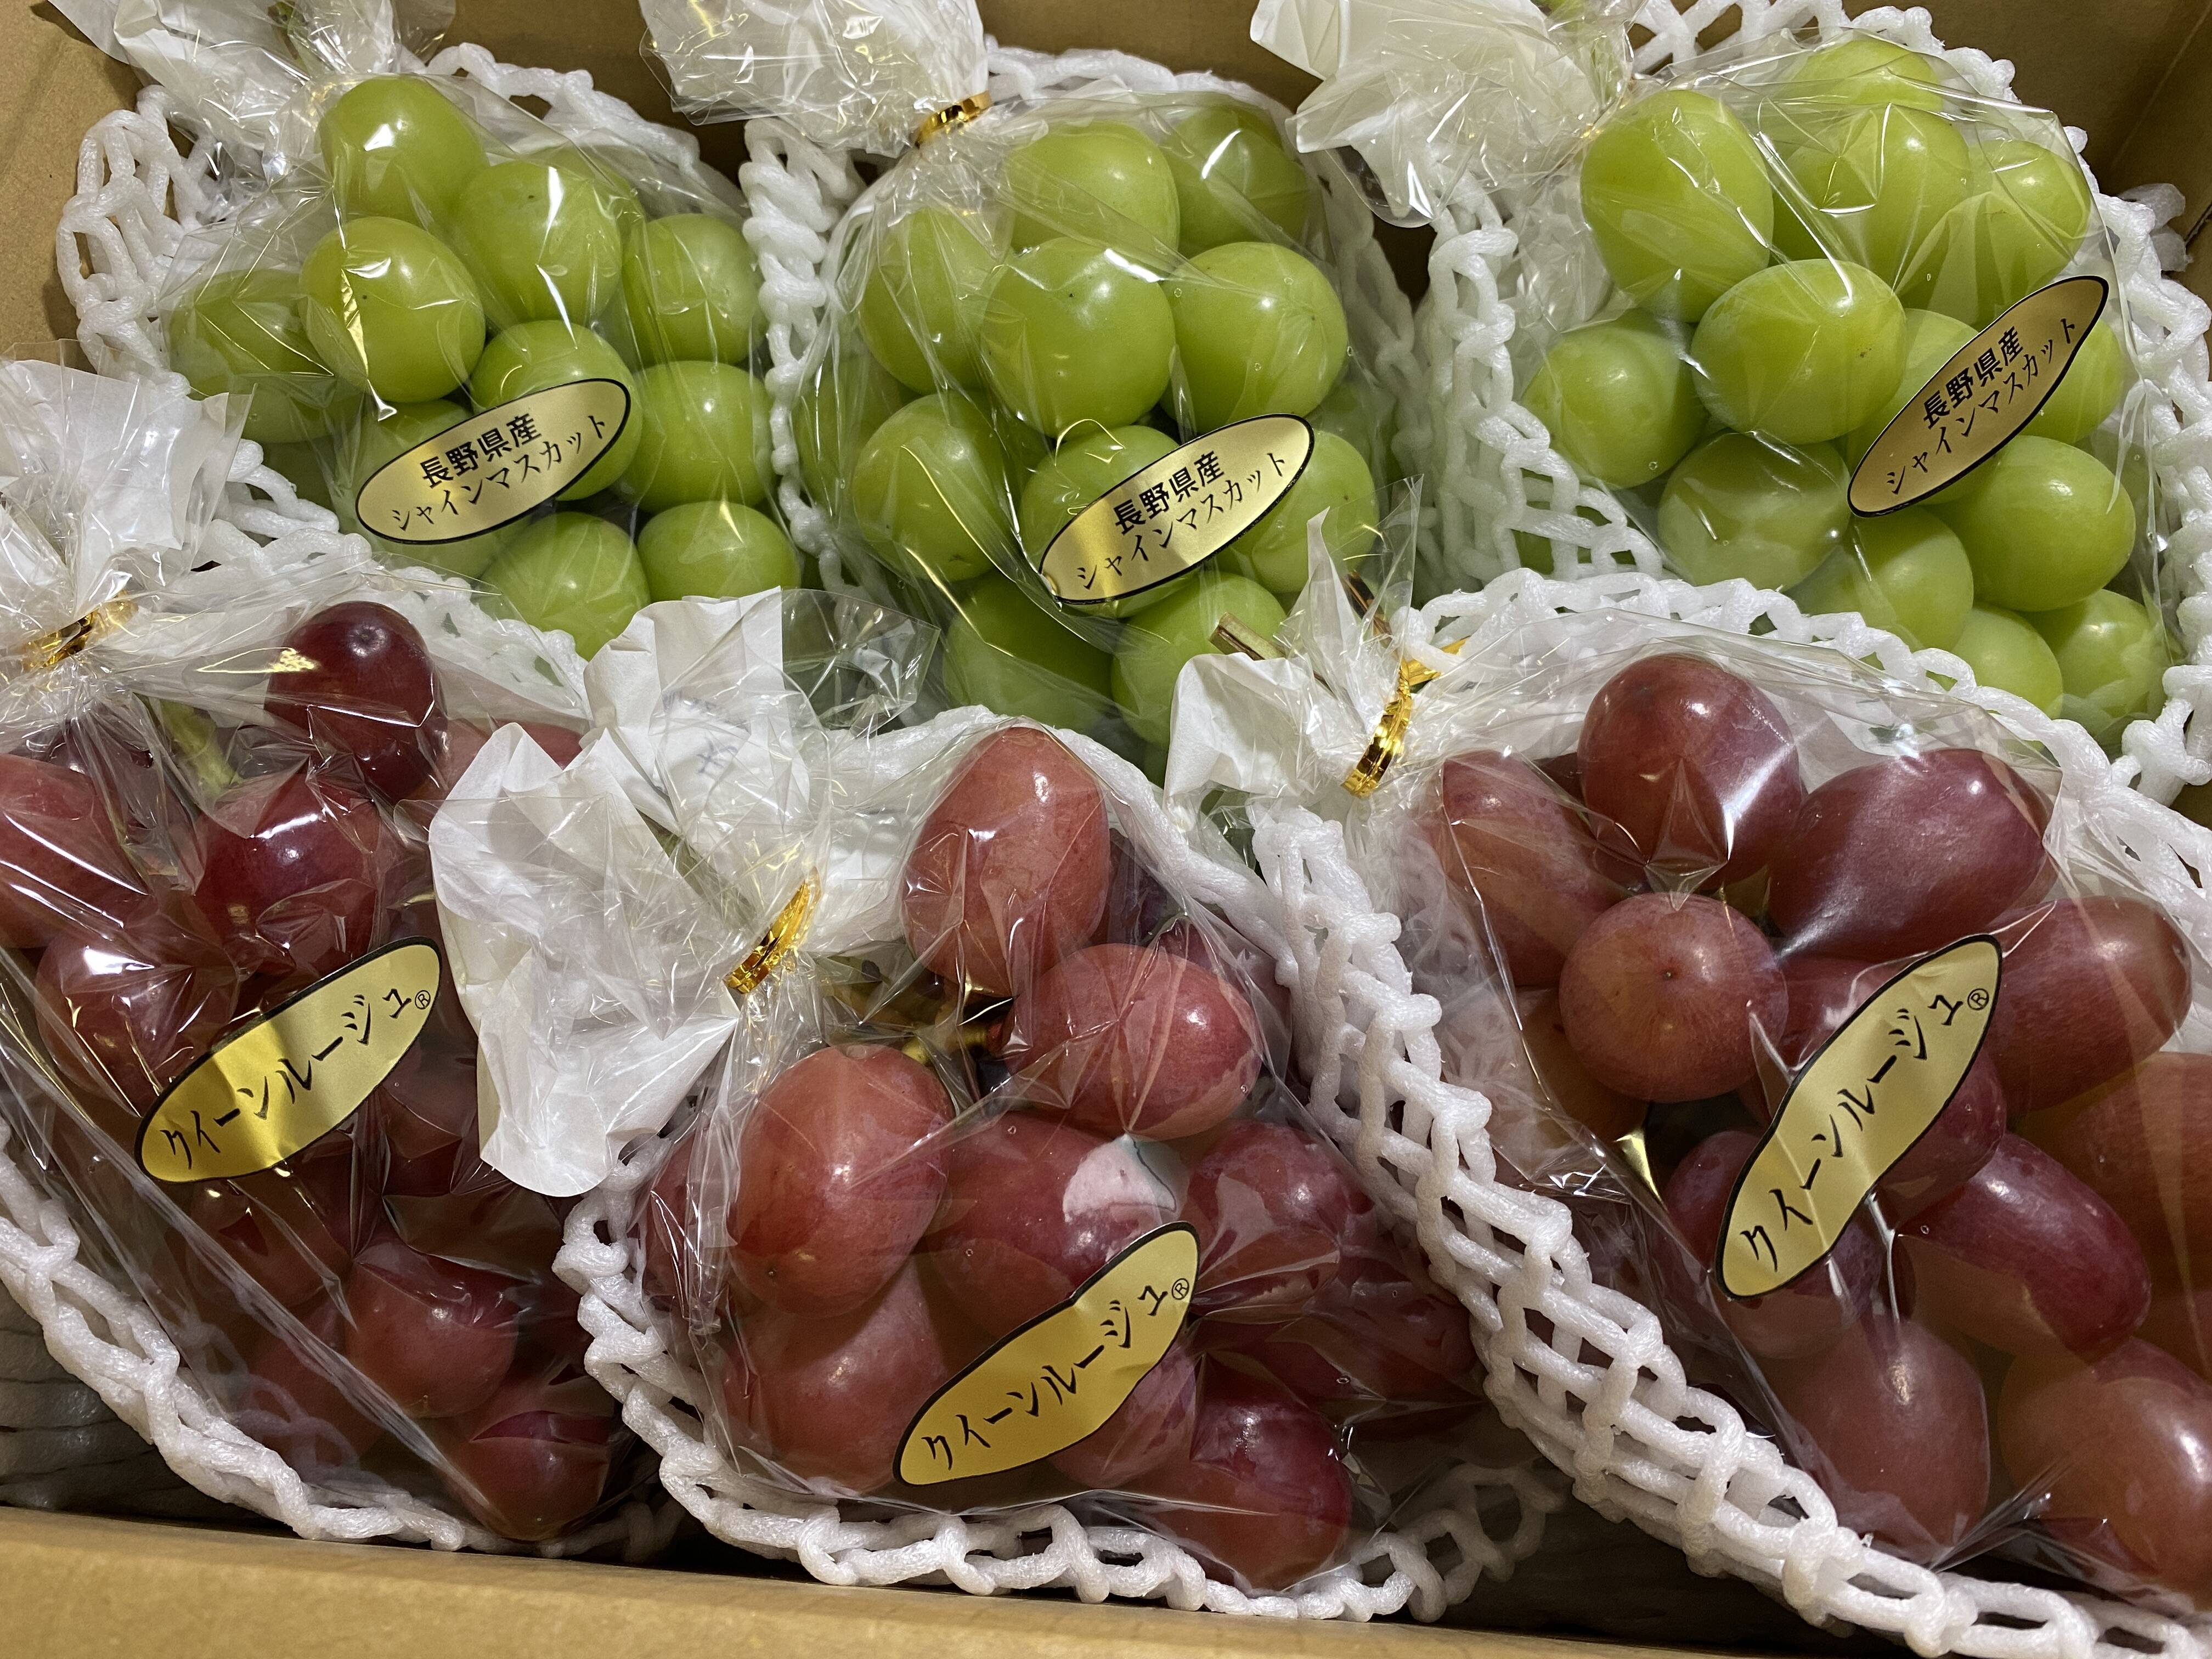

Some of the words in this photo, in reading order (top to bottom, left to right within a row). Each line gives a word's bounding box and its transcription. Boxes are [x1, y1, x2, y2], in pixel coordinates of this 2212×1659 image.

[1886, 318, 2075, 495] シャインマスカット
[1923, 326, 2024, 430] 長野県産
[392, 415, 605, 531] シャインマスカット
[420, 413, 541, 488] 長野県産
[1113, 450, 1225, 535] 長野県産
[1077, 452, 1285, 590] シャインマスカット
